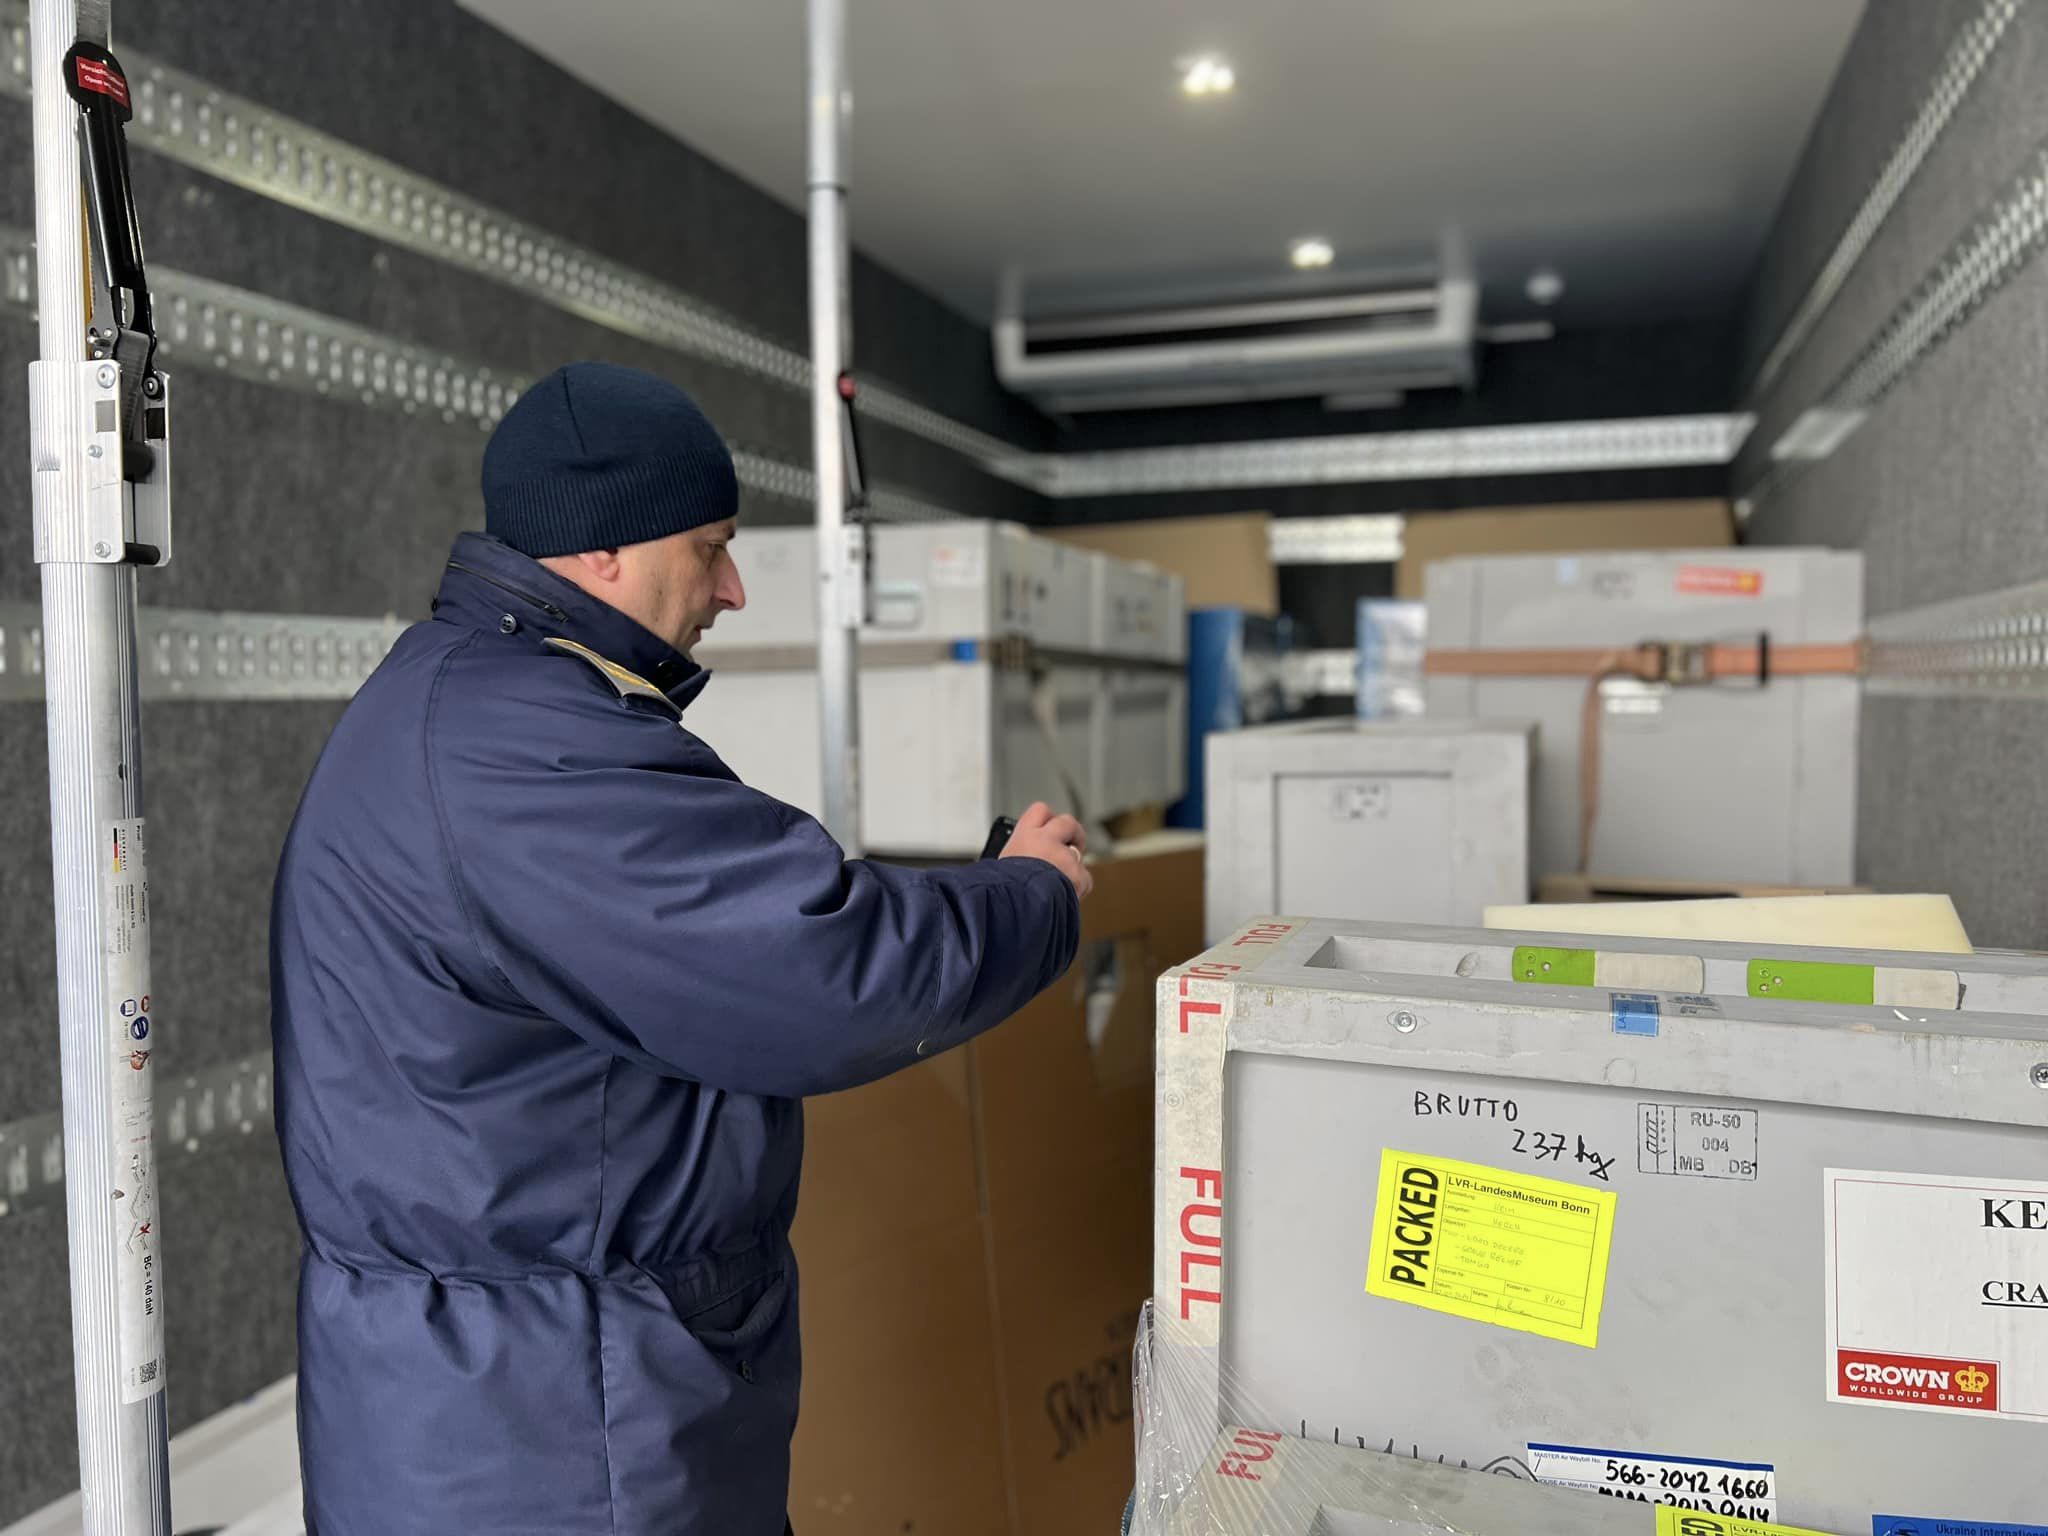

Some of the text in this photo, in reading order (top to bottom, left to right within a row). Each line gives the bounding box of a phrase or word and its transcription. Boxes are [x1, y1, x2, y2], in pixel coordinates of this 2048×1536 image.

[1232, 923, 1292, 946] FULL
[1414, 1091, 1519, 1122] BRUTTO
[1690, 1111, 1742, 1129] RU-50
[1512, 1128, 1617, 1181] 237 kg
[1702, 1137, 1730, 1152] 004
[1679, 1156, 1753, 1175] MB DB
[1448, 1176, 1558, 1208] LVR-LandesMuseum
[1561, 1200, 1591, 1215] Bonn
[1389, 1166, 1440, 1289] PACKED
[1179, 1167, 1223, 1320] FULL
[143, 1255, 152, 1270] BC
[144, 1279, 153, 1297] 140
[145, 1298, 155, 1315] daN
[1845, 1362, 1950, 1389] CROWN
[1849, 1385, 1983, 1404] WORLDWIDE GROUP
[1534, 1452, 1560, 1460] MASTER
[1570, 1456, 1590, 1464] Waybill
[1606, 1459, 1769, 1499] 566-2042 1660
